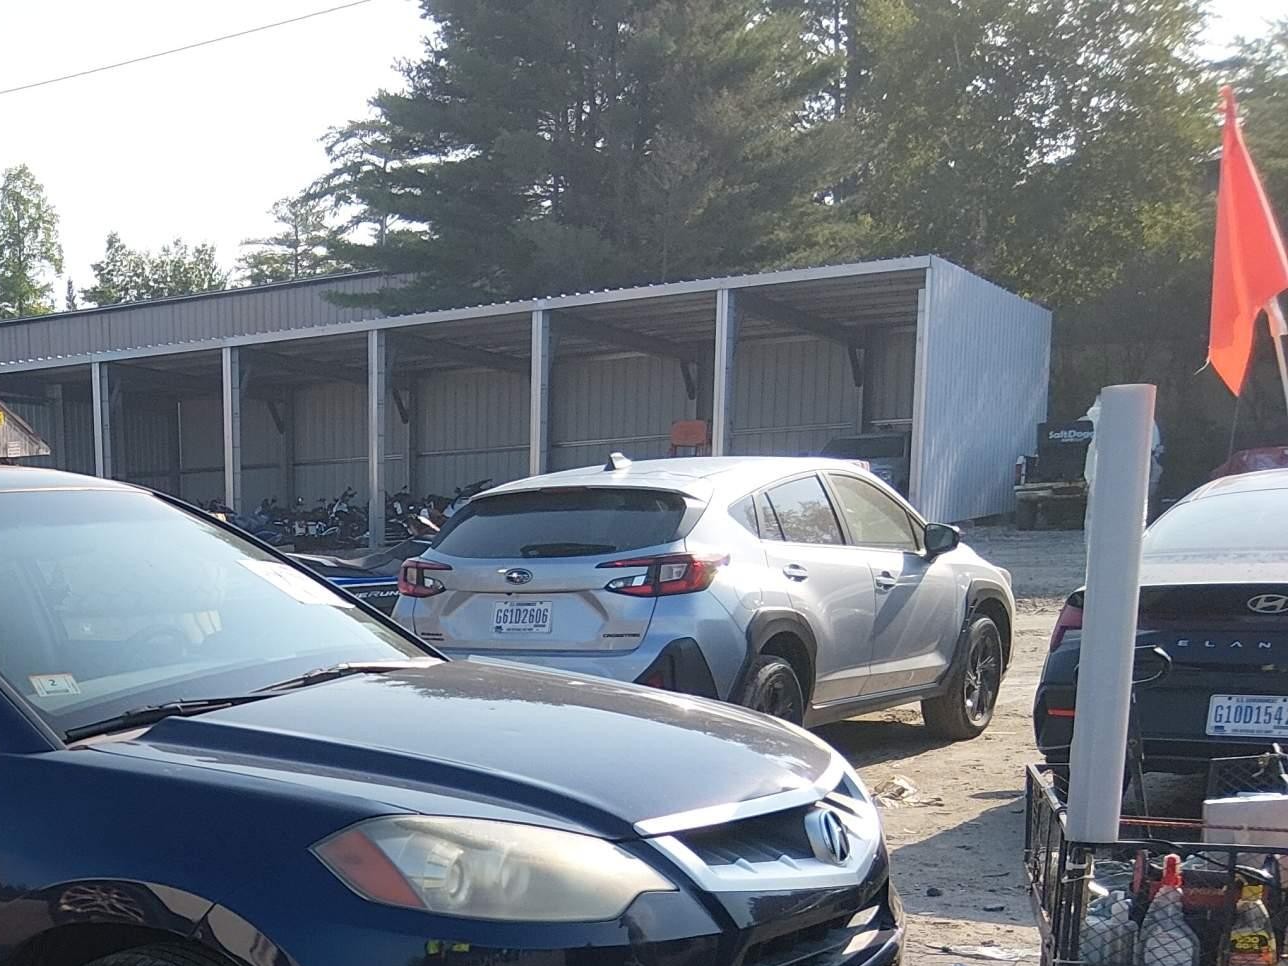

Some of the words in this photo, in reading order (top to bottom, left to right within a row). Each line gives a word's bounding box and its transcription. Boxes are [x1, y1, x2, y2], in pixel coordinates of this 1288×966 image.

[356, 587, 402, 598] ERUN
[495, 608, 549, 625] G61D2606
[1177, 639, 1272, 649] ELAN
